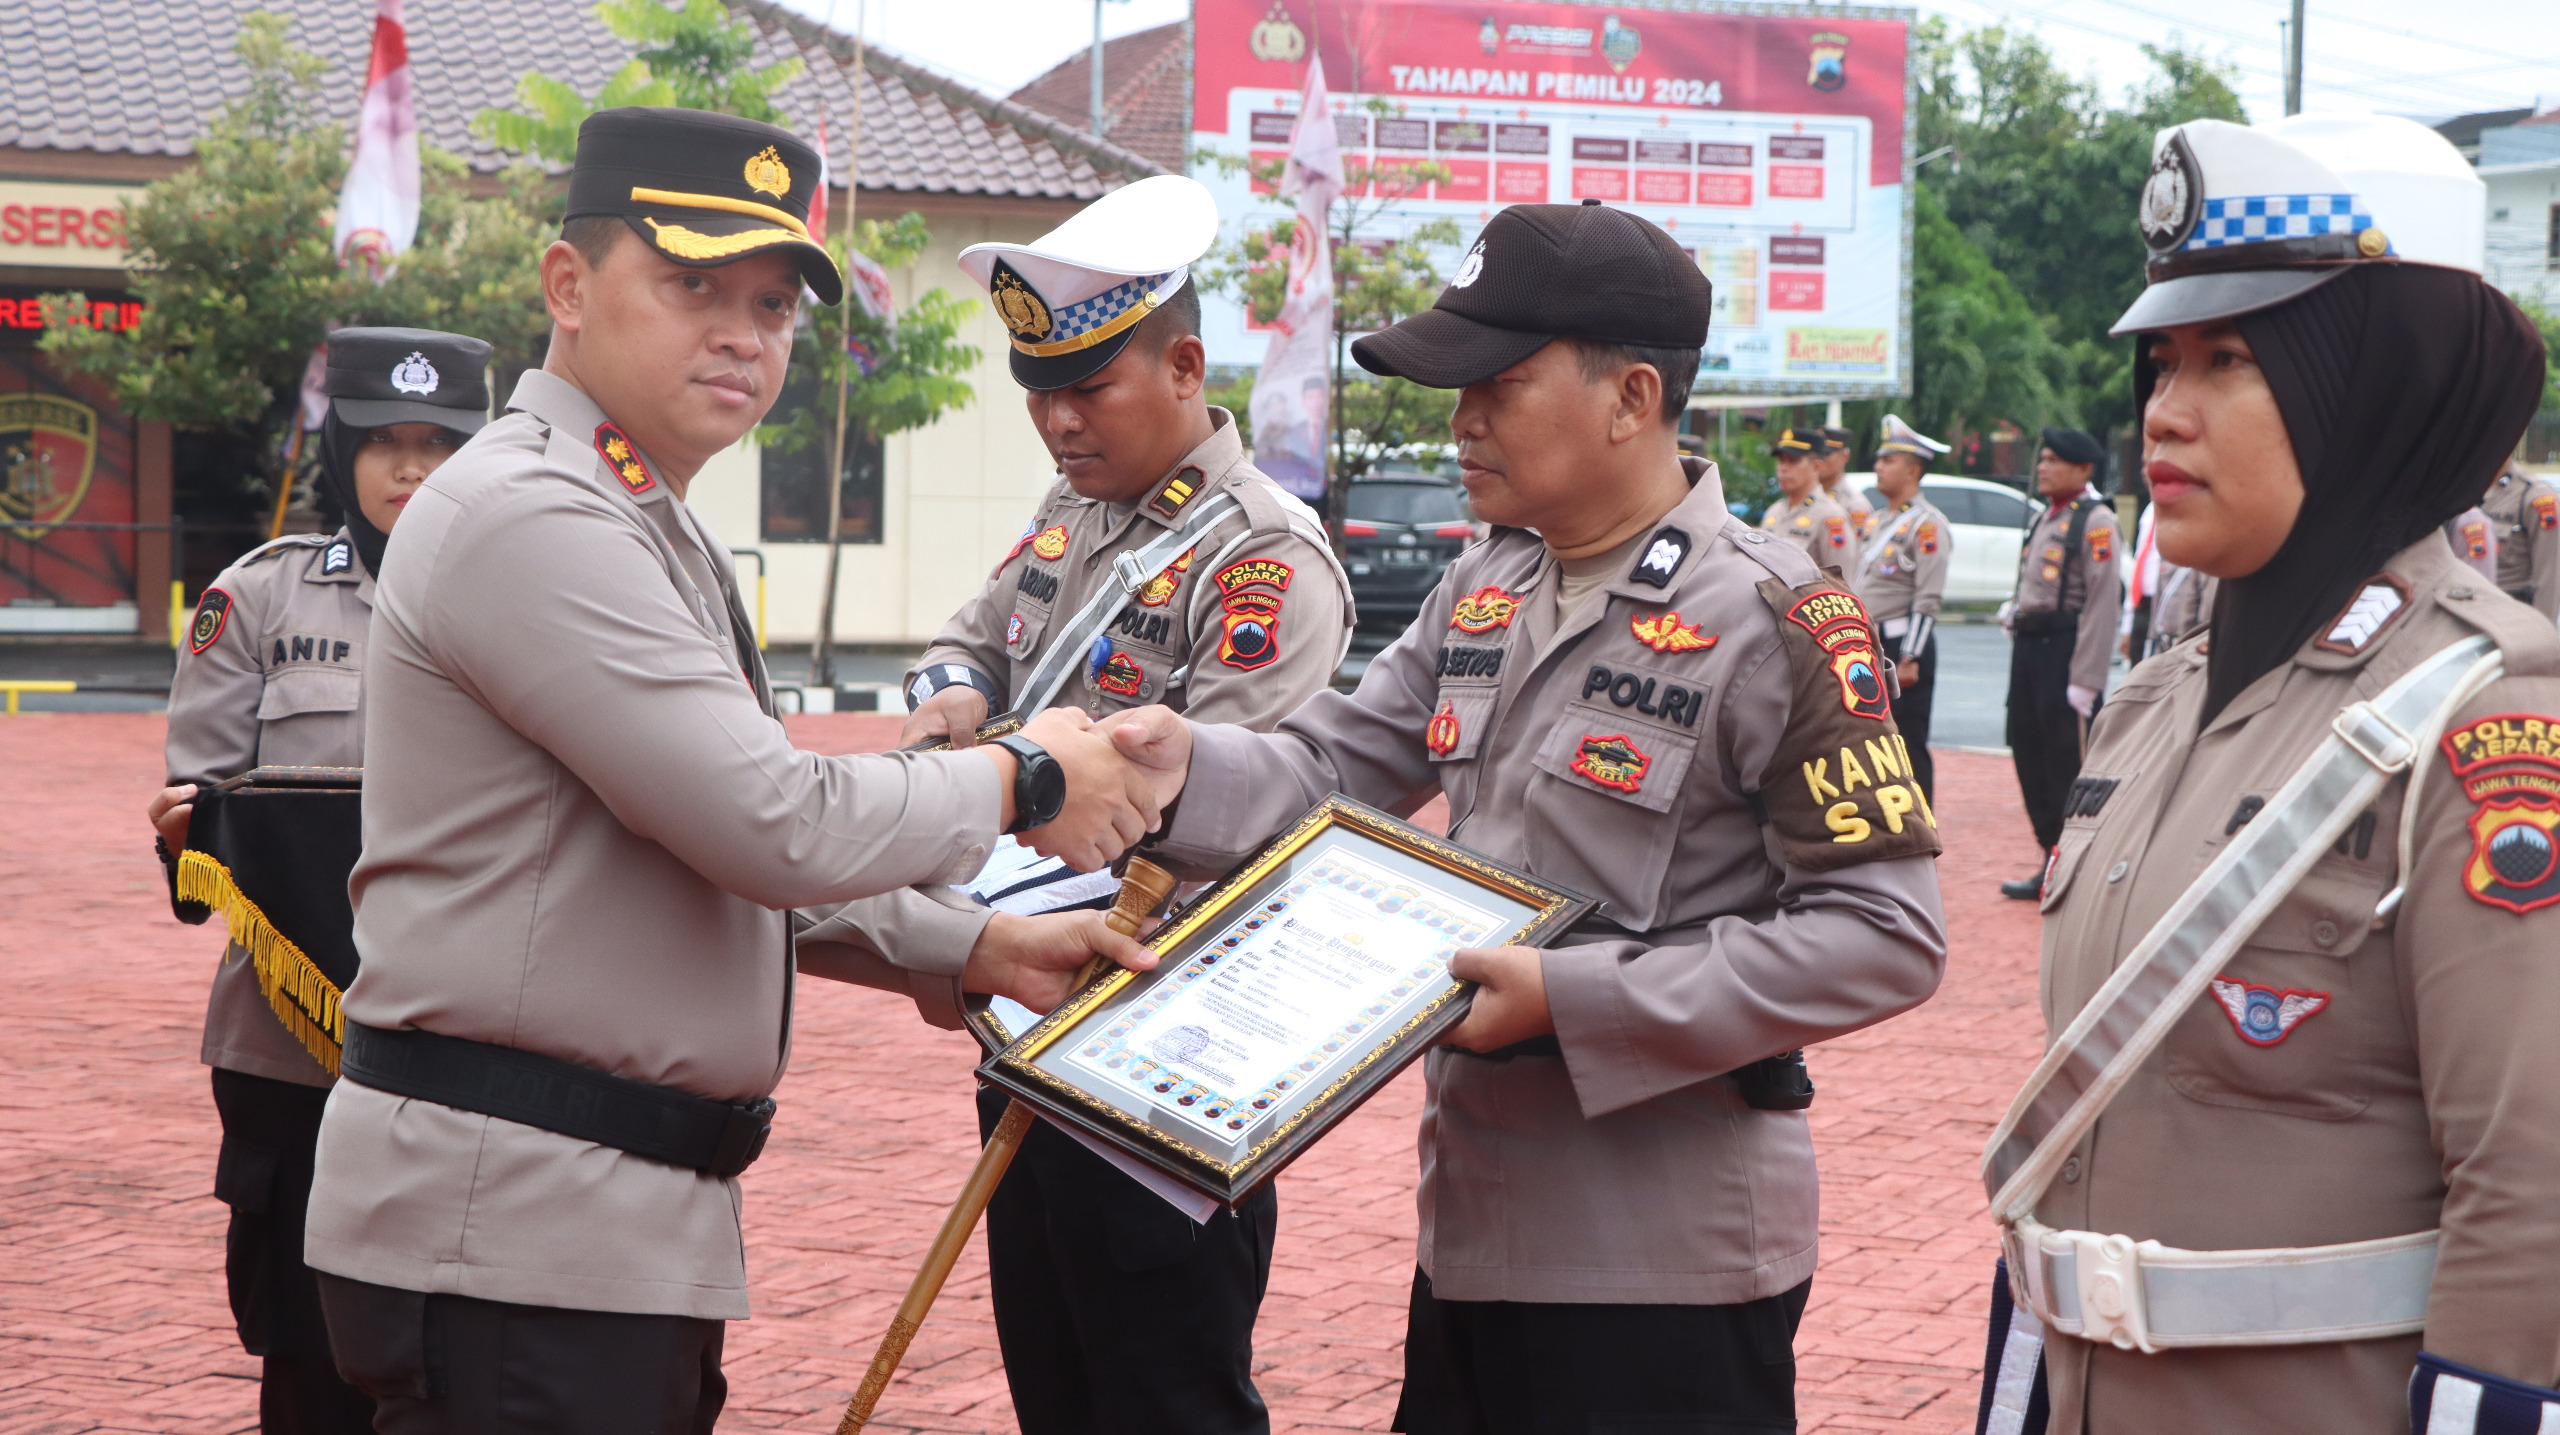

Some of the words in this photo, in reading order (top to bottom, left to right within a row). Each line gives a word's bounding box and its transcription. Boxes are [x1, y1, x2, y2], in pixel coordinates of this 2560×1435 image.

[1391, 65, 1528, 95] TAHAPAN
[1536, 71, 1645, 102] PEMILU
[1652, 78, 1722, 106] 2024
[1221, 562, 1289, 582] POLRES
[1230, 571, 1280, 588] JEPARA
[1227, 596, 1246, 606] JAWA
[1248, 595, 1278, 607] TENGAH
[1801, 595, 1854, 616] POLRES
[1809, 604, 1862, 627] JEPARA
[1109, 608, 1170, 645] POLRI
[272, 635, 350, 666] ANIF
[1823, 632, 1842, 648] JAWA
[1582, 666, 1702, 727] POLRI
[1583, 761, 1629, 782] SNIPER
[2472, 777, 2509, 795] JAWA
[1281, 917, 1327, 942] Piagam
[1325, 937, 1398, 974] Penghargaan
